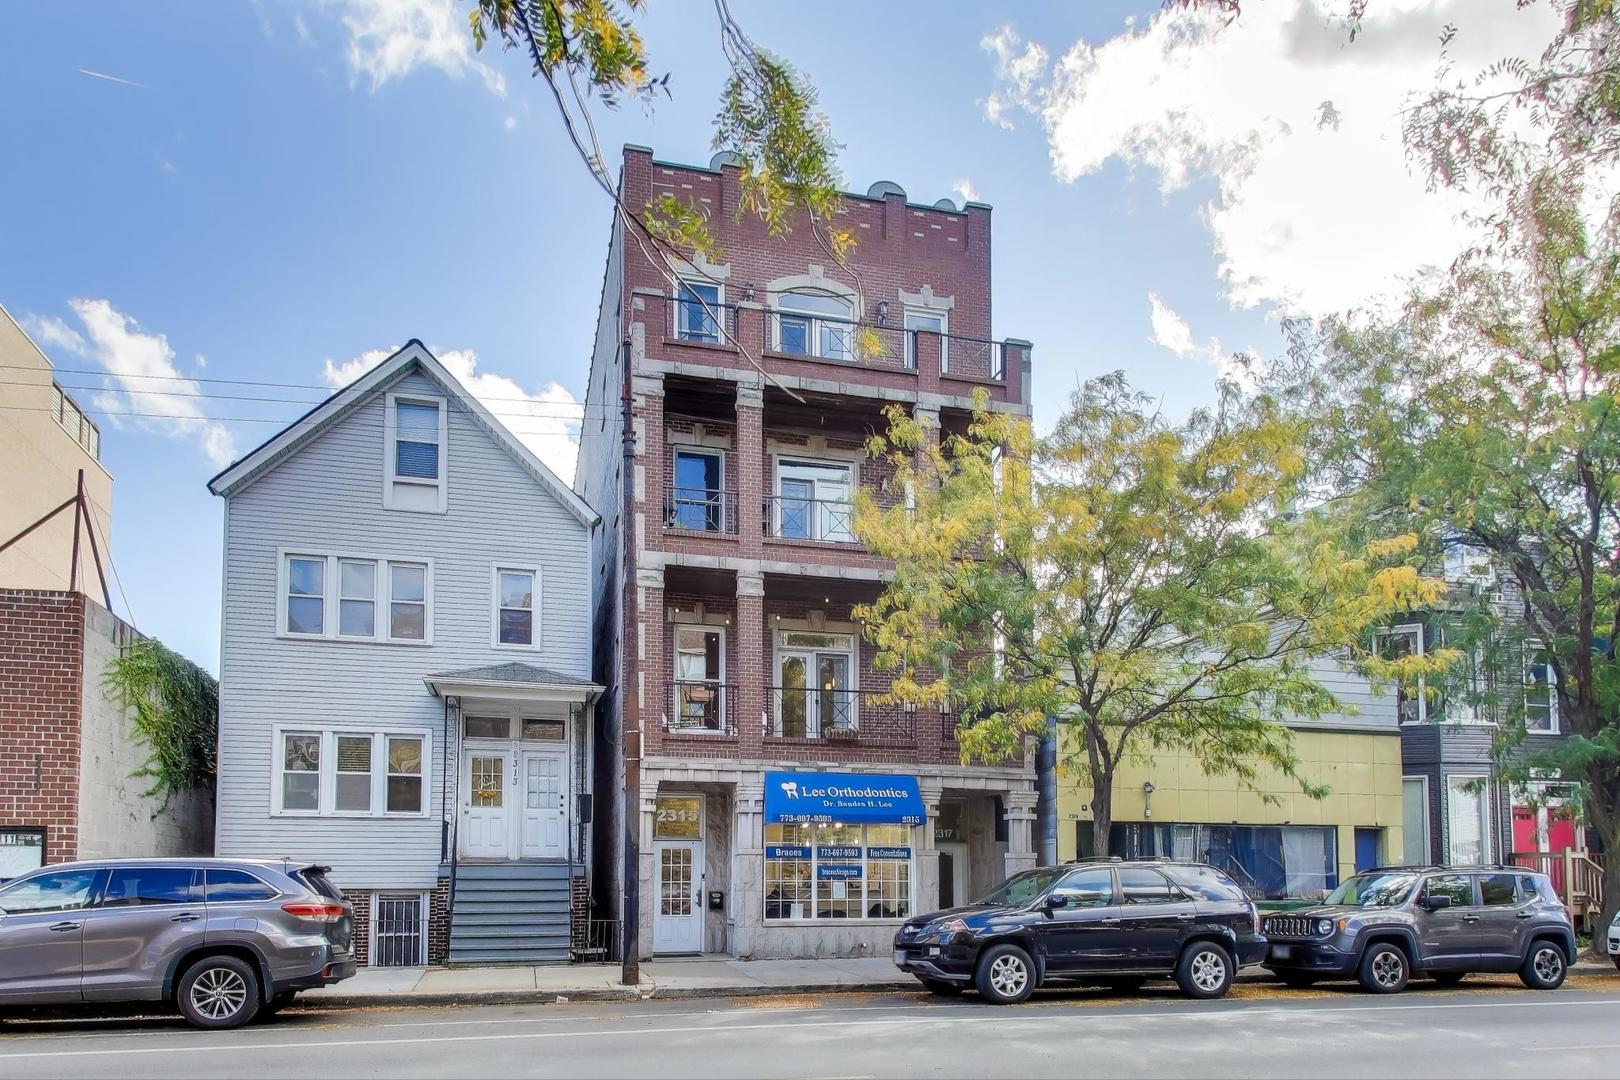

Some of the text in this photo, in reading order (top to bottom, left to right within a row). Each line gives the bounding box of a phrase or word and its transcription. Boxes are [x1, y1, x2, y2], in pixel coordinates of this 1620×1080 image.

[802, 787, 908, 798] Lee Orthodontics
[823, 800, 836, 808] Dr.
[657, 808, 697, 821] 2315
[902, 815, 920, 823] 2315
[775, 848, 802, 857] Braces
[820, 848, 858, 857] 773-697-9593
